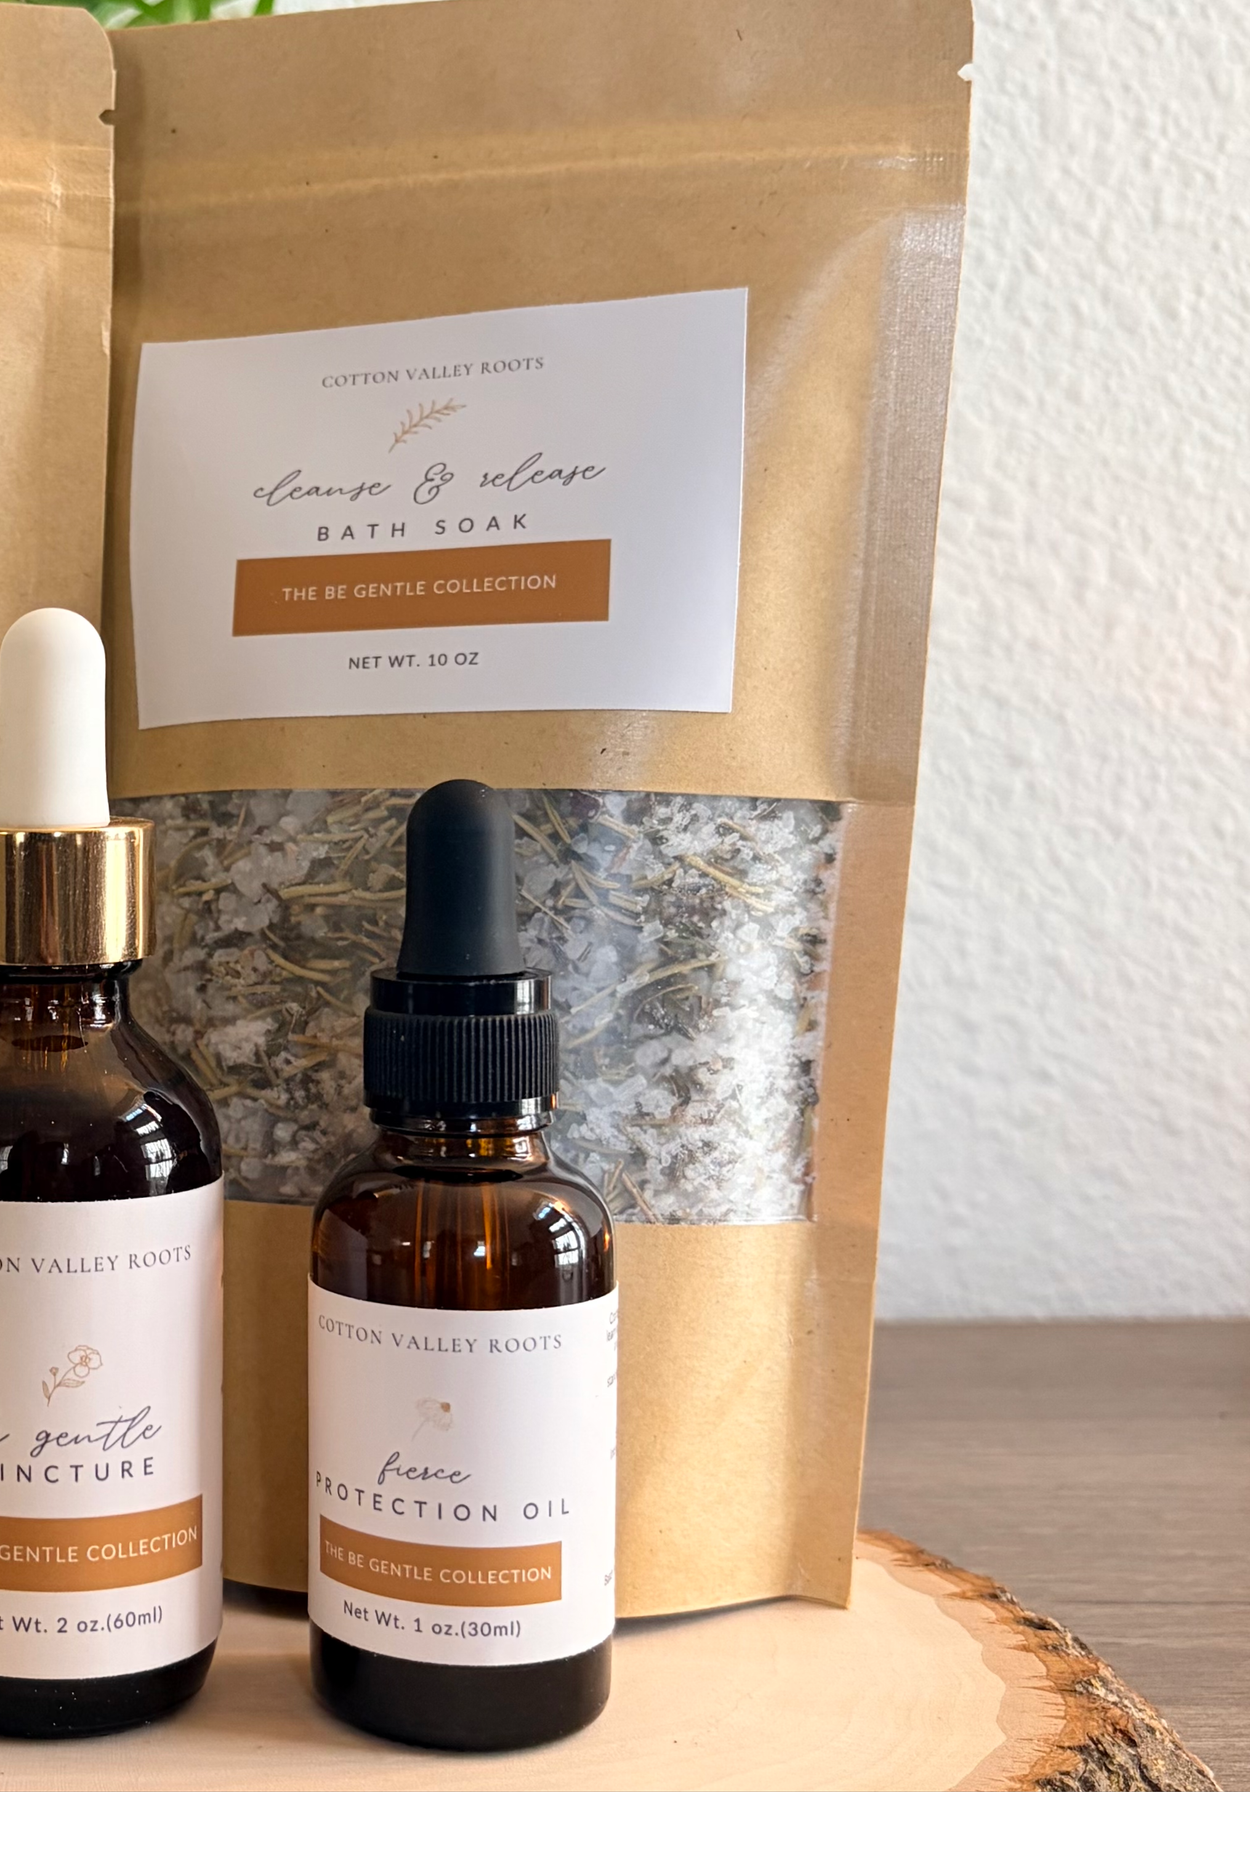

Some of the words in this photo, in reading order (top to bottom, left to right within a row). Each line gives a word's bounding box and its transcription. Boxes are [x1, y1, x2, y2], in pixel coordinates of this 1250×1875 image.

[322, 368, 400, 388] COTTON
[406, 362, 474, 382] VALLEY
[480, 356, 544, 375] ROOTS
[253, 470, 392, 506] cleanse
[414, 462, 454, 504] &
[480, 452, 606, 491] release
[318, 522, 406, 542] BATH
[435, 514, 528, 536] SOAK
[282, 586, 318, 602] THE
[325, 584, 348, 600] BE
[354, 580, 426, 599] GENTLE
[432, 574, 557, 594] COLLECTION
[348, 655, 382, 670] NET
[388, 654, 420, 668] WT.
[428, 653, 448, 667] 10
[454, 651, 479, 666] OZ
[31, 1254, 119, 1274] VALLEY
[129, 1244, 192, 1269] ROOTS
[318, 1314, 382, 1345] COTTON
[391, 1333, 477, 1353] VALLEY
[489, 1334, 562, 1353] ROOTS
[30, 1406, 162, 1457] gentle
[377, 1451, 472, 1485] fierce
[316, 1471, 498, 1522] PROTECTION
[524, 1498, 570, 1520] OIL
[86, 1527, 198, 1563] COLLECTION
[324, 1540, 344, 1562] THE
[348, 1551, 364, 1568] BE
[369, 1557, 433, 1582] GENTLE
[440, 1566, 552, 1584] COLLECTION
[13, 1613, 48, 1634] Wt.
[57, 1617, 68, 1634] 2
[343, 1601, 368, 1622] Net
[375, 1610, 405, 1631] Wt.
[413, 1618, 423, 1633] 1
